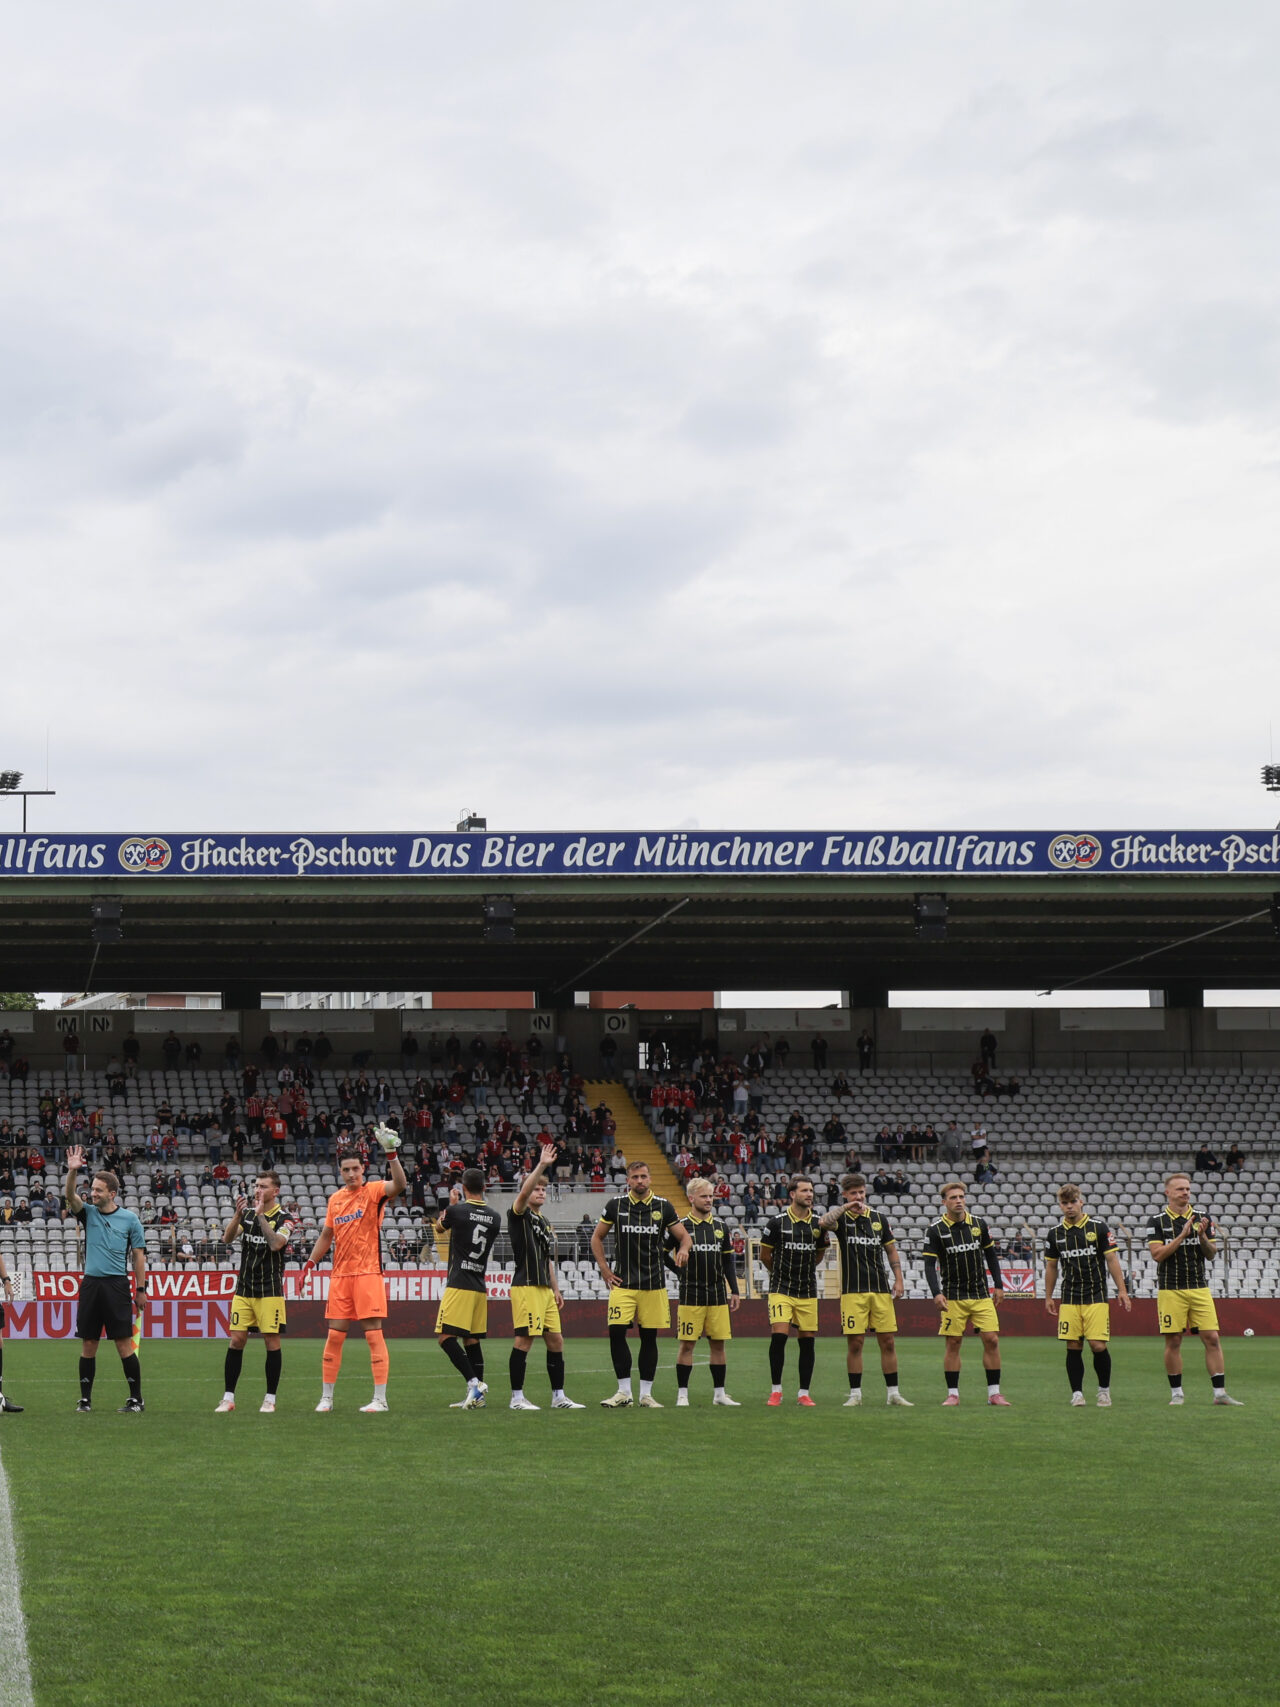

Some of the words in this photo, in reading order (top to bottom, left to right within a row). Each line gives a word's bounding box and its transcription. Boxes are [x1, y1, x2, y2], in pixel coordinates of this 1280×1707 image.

[180, 837, 398, 875] Hacker-Pschorr
[408, 837, 470, 868] Das
[481, 835, 555, 868] Bier
[563, 836, 626, 867] der
[633, 834, 814, 867] Münchner
[821, 834, 1036, 871] Fußballfans
[62, 1016, 77, 1032] M
[93, 1016, 106, 1032] N
[538, 1015, 551, 1030] N
[607, 1015, 622, 1031] O
[469, 1212, 494, 1225] SCHWARZ
[621, 1224, 660, 1235] maxit
[468, 1223, 488, 1260] 5
[847, 1235, 882, 1246] maxit
[946, 1239, 981, 1255] maxit
[1060, 1244, 1098, 1259] maxit
[608, 1306, 622, 1320] 25
[772, 1304, 784, 1318] 11
[536, 1316, 542, 1331] 2
[680, 1322, 694, 1336] 16
[847, 1315, 856, 1329] 6
[944, 1317, 952, 1332] 7
[1059, 1321, 1070, 1335] 19
[1163, 1314, 1173, 1329] 9
